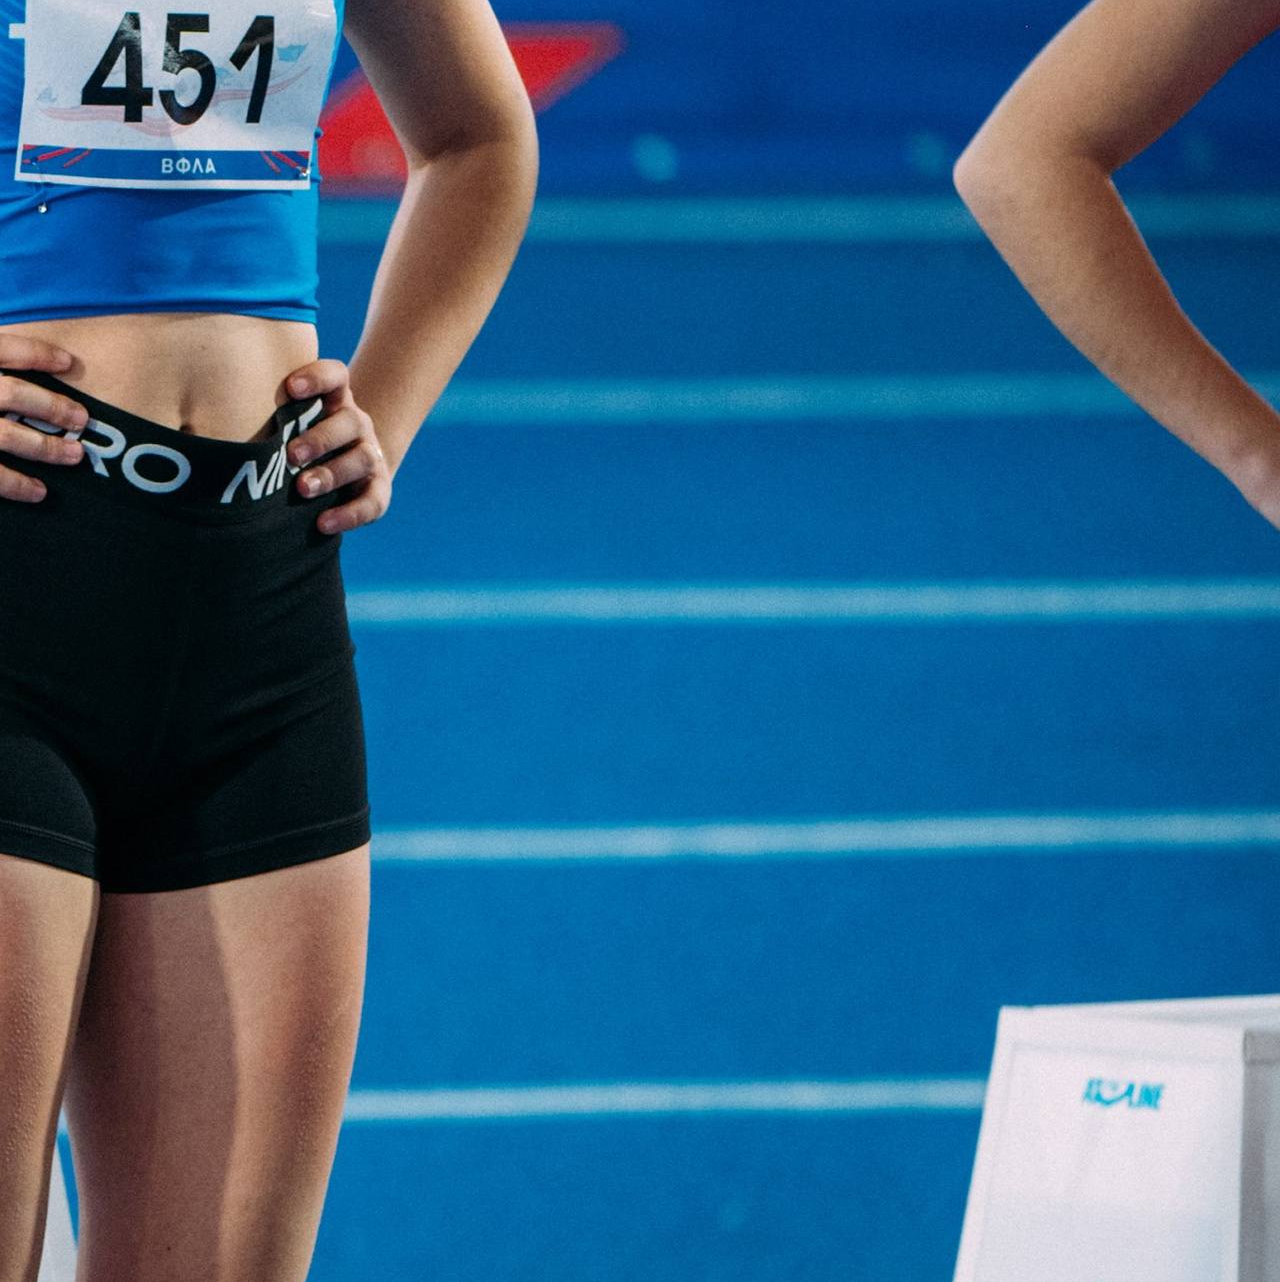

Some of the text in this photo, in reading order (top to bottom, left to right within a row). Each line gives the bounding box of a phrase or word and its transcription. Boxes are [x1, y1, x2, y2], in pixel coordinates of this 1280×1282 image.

[81, 11, 276, 126] 451
[161, 157, 217, 174] ВФЛА
[4, 412, 191, 494] RO
